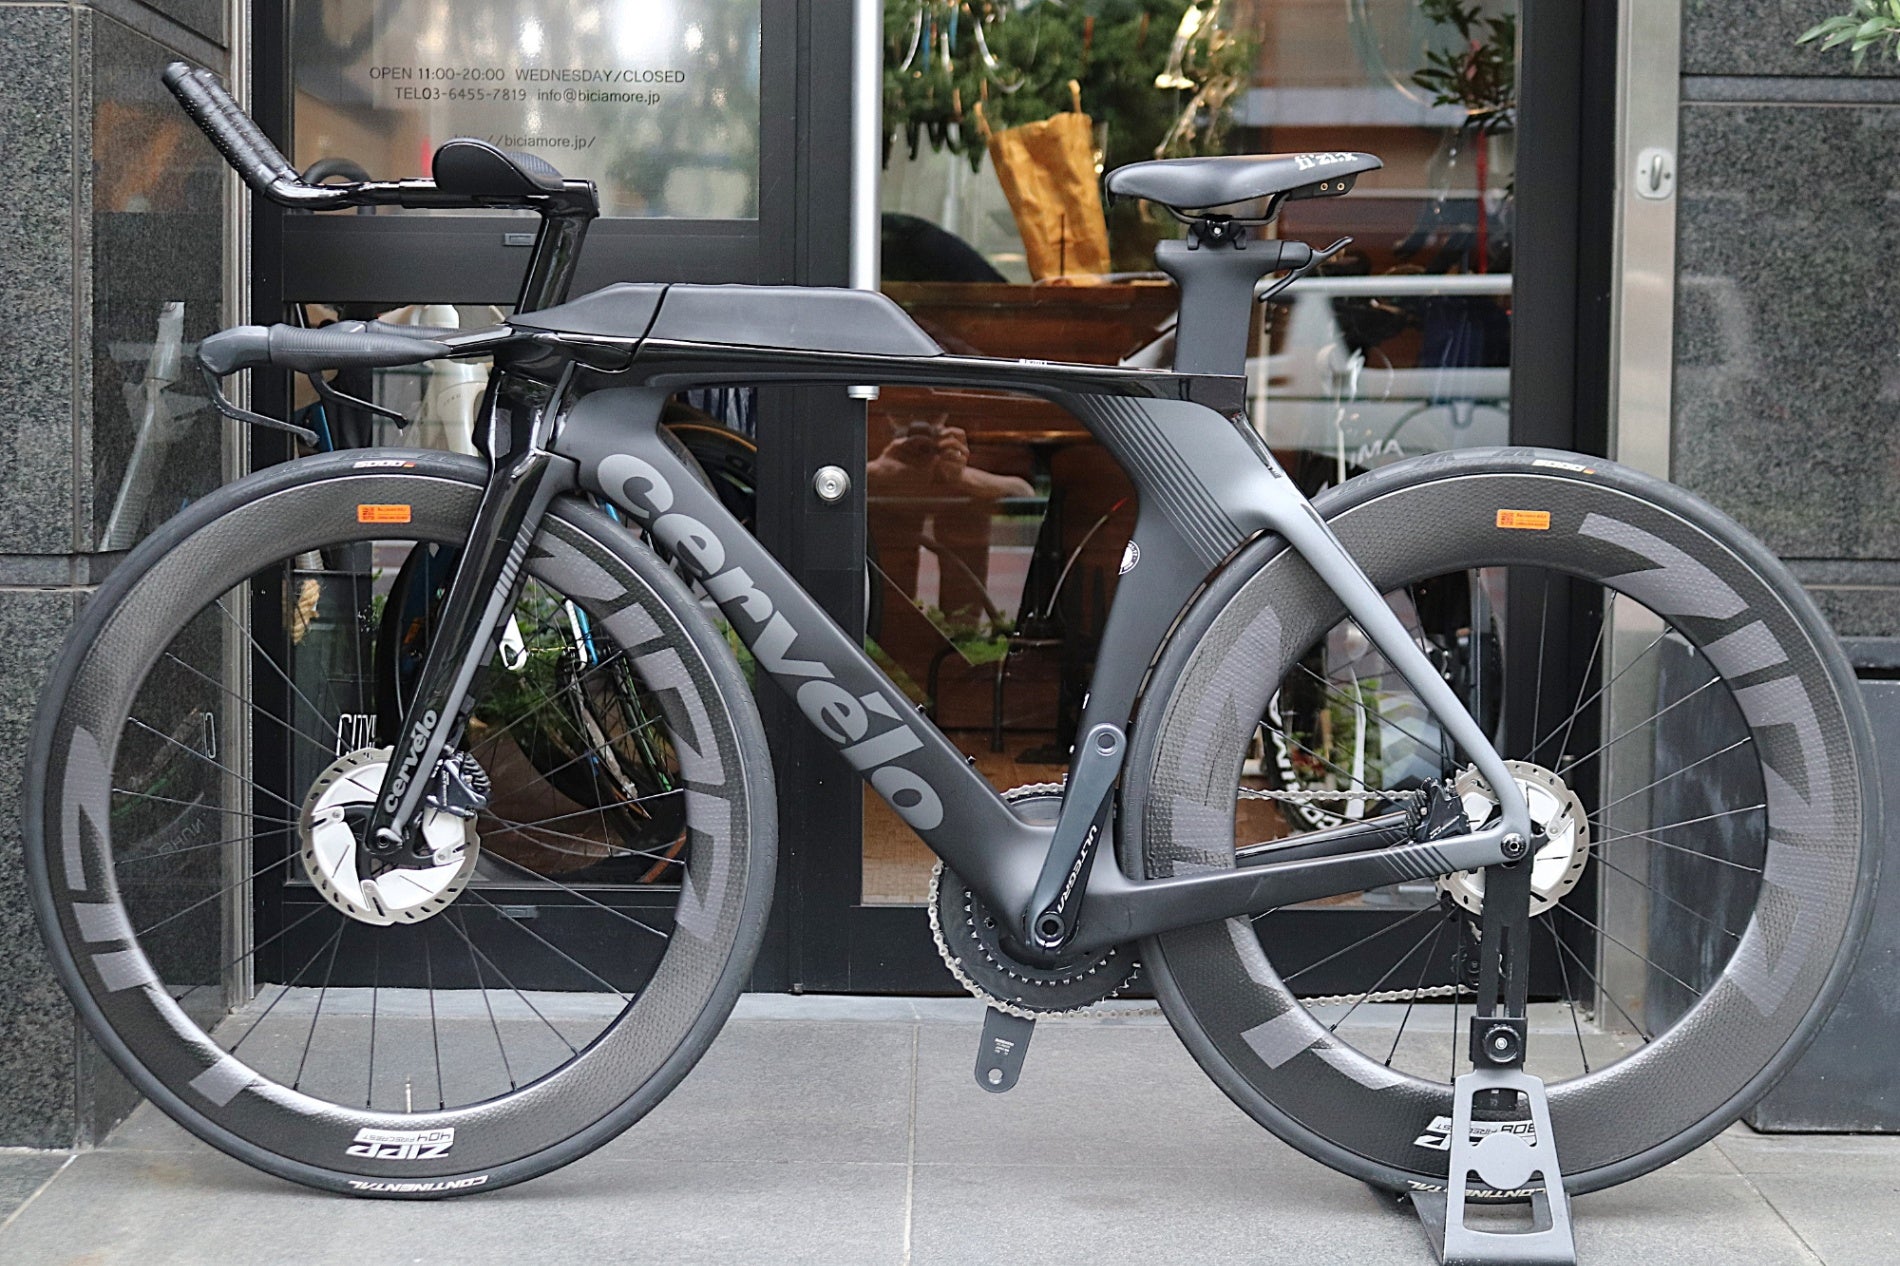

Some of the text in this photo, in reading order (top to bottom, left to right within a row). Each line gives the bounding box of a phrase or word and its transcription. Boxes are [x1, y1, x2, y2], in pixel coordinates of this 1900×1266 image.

[370, 67, 685, 83] OPEN 11:00-20:00 WEDNESDAY/CLOSED
[394, 87, 661, 106] TEL03-6455-7819 info@biciamore.jp
[454, 134, 597, 151] //biciamore.jp/
[384, 709, 438, 813] cervélo
[1057, 825, 1098, 914] ULTEGRA
[416, 1131, 451, 1143] 404
[1434, 1123, 1498, 1135] FIREST
[345, 1142, 454, 1161] ZIPP
[348, 1174, 489, 1193] CONTINENTAL
